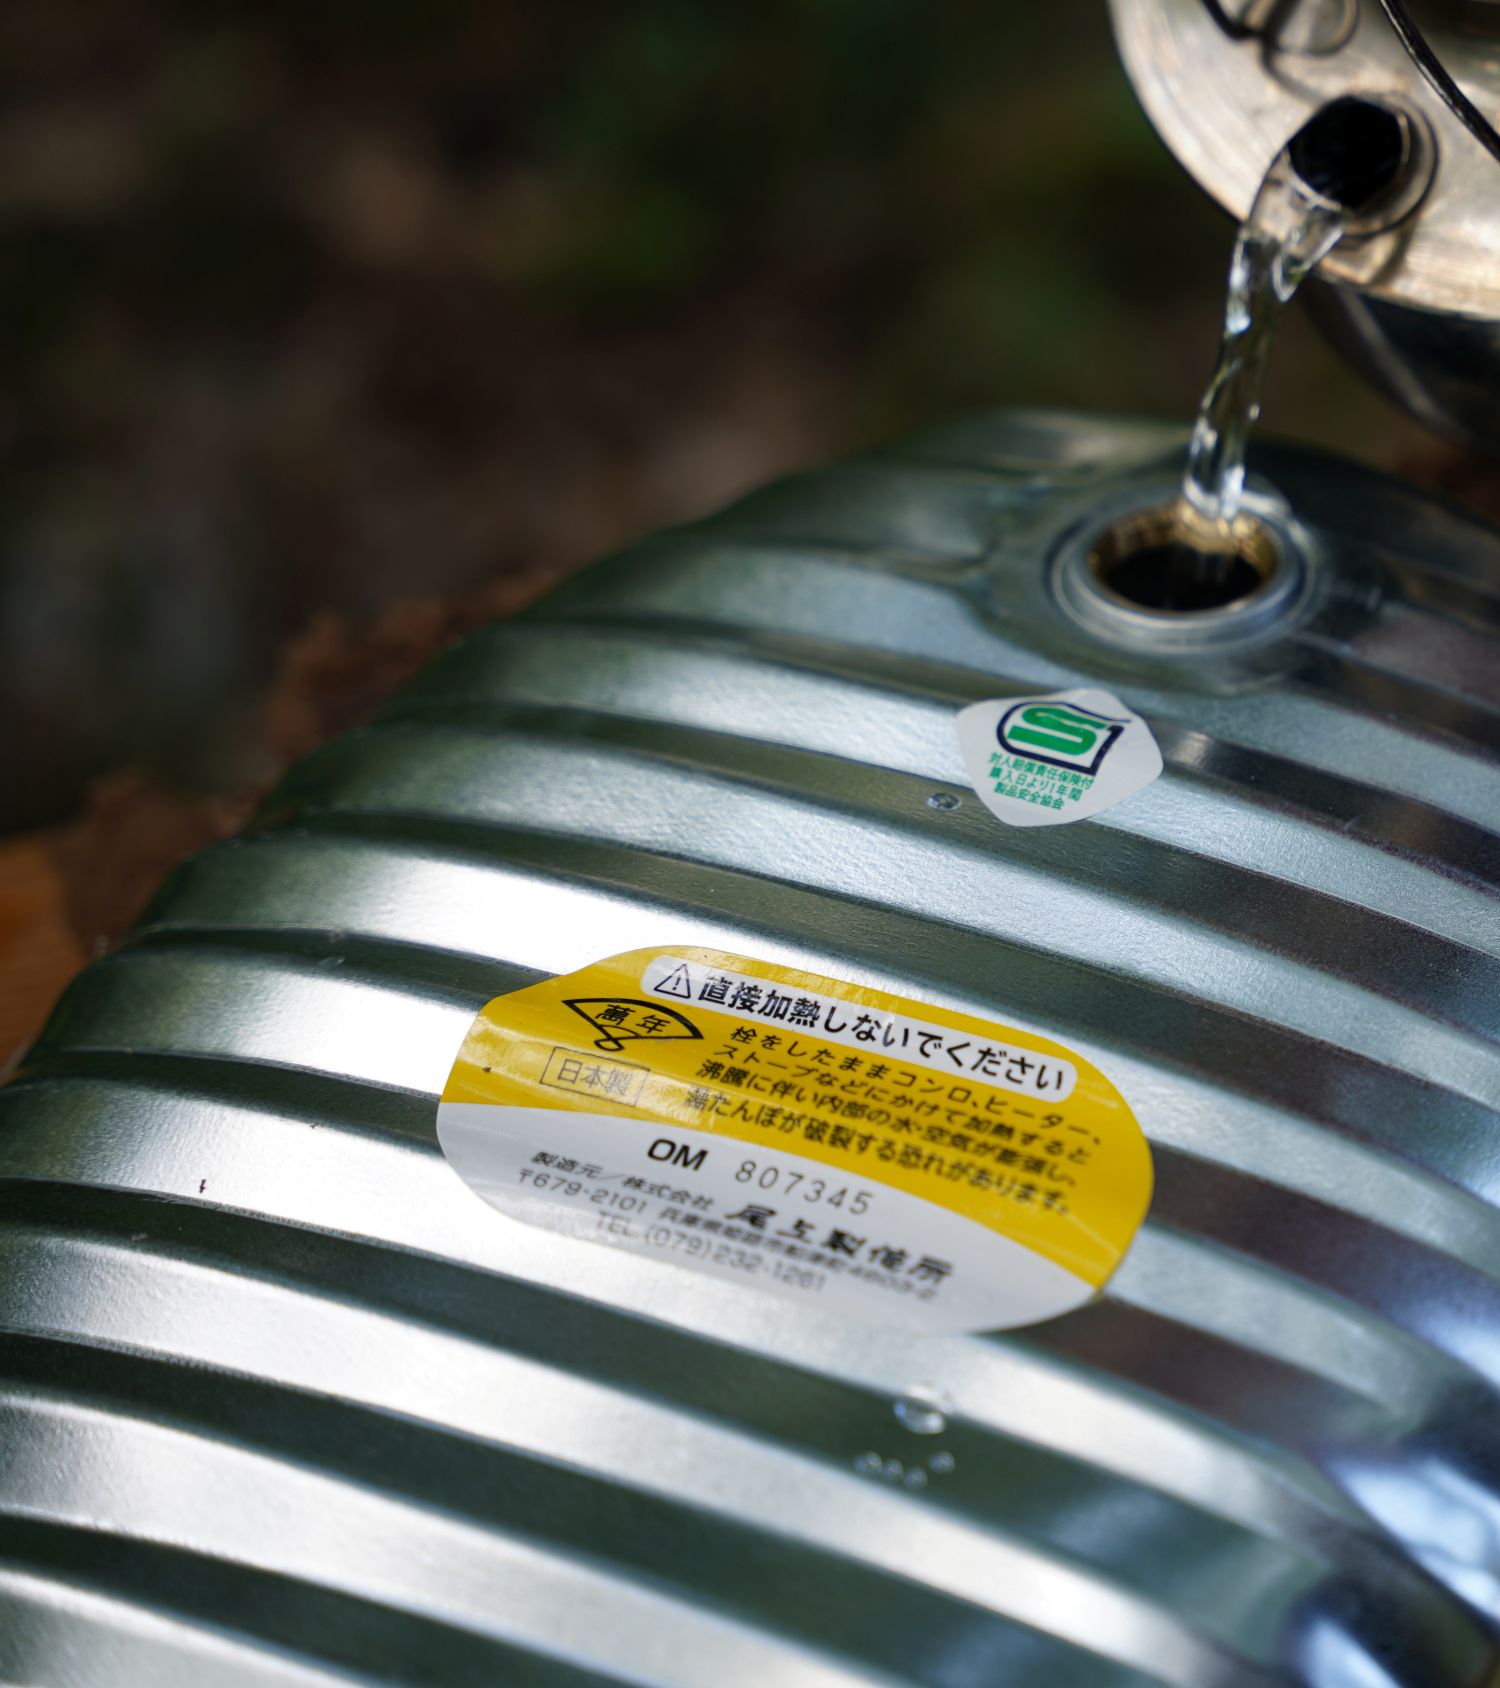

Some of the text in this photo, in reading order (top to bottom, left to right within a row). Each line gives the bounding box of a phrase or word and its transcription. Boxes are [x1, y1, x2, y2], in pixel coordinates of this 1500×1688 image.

[988, 752, 1095, 790] 対人賠償責任保険付
[993, 782, 1065, 810] 製品安全協会
[595, 1003, 671, 1034] 萬年
[698, 975, 1064, 1090] 直接加熱しないでください
[557, 1058, 633, 1096] 日本製
[648, 1138, 873, 1214] OM 807345
